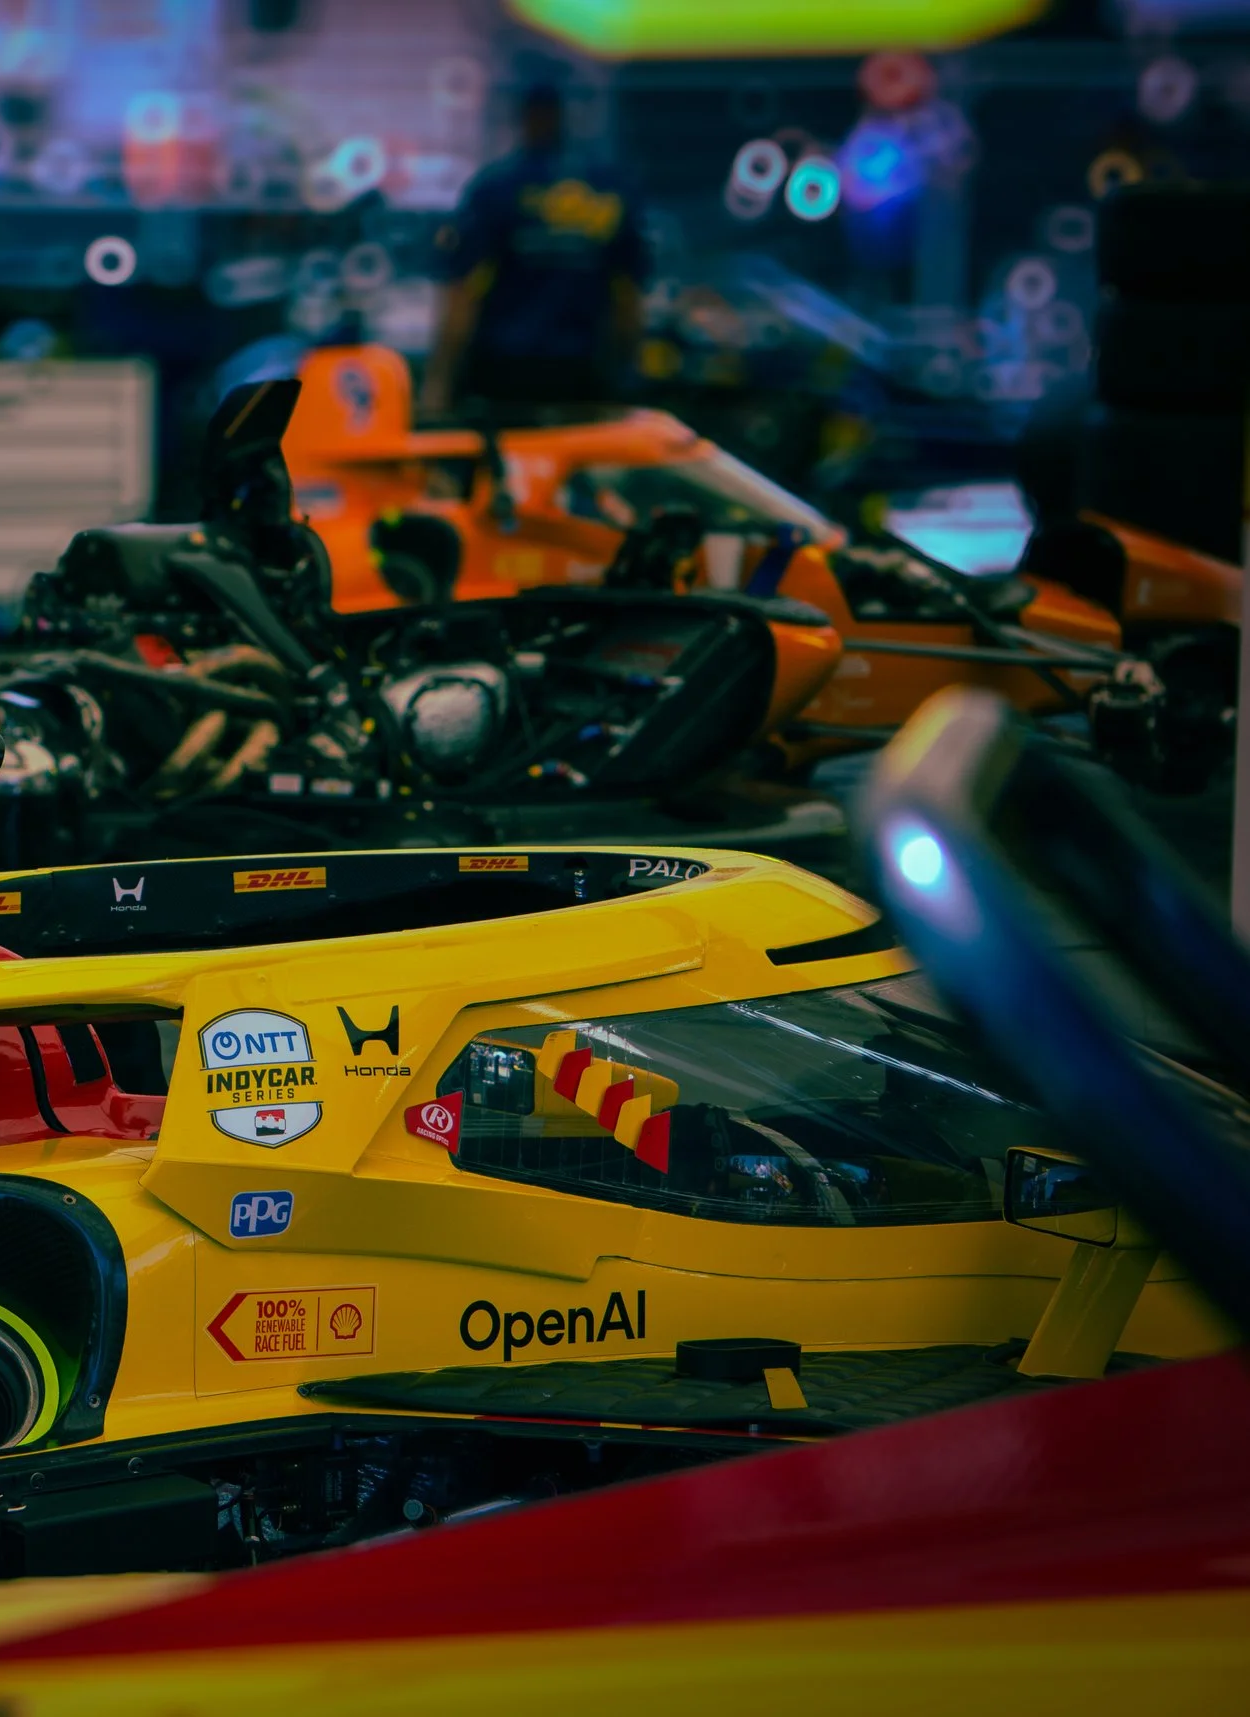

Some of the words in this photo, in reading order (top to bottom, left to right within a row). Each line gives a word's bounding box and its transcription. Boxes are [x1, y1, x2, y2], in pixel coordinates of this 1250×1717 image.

[468, 858, 519, 870] DHL
[246, 871, 312, 889] DHL
[110, 904, 147, 912] Honda
[246, 1031, 297, 1054] NTT
[207, 1066, 317, 1093] INDYCAR
[344, 1065, 412, 1077] Honda
[232, 1088, 295, 1103] SERIES
[233, 1196, 290, 1233] PPG
[256, 1298, 306, 1319] 100%
[255, 1318, 306, 1334] RENEWABLE
[459, 1289, 646, 1362] OpenAI
[255, 1334, 281, 1353] RACE
[282, 1333, 307, 1351] FUEL
